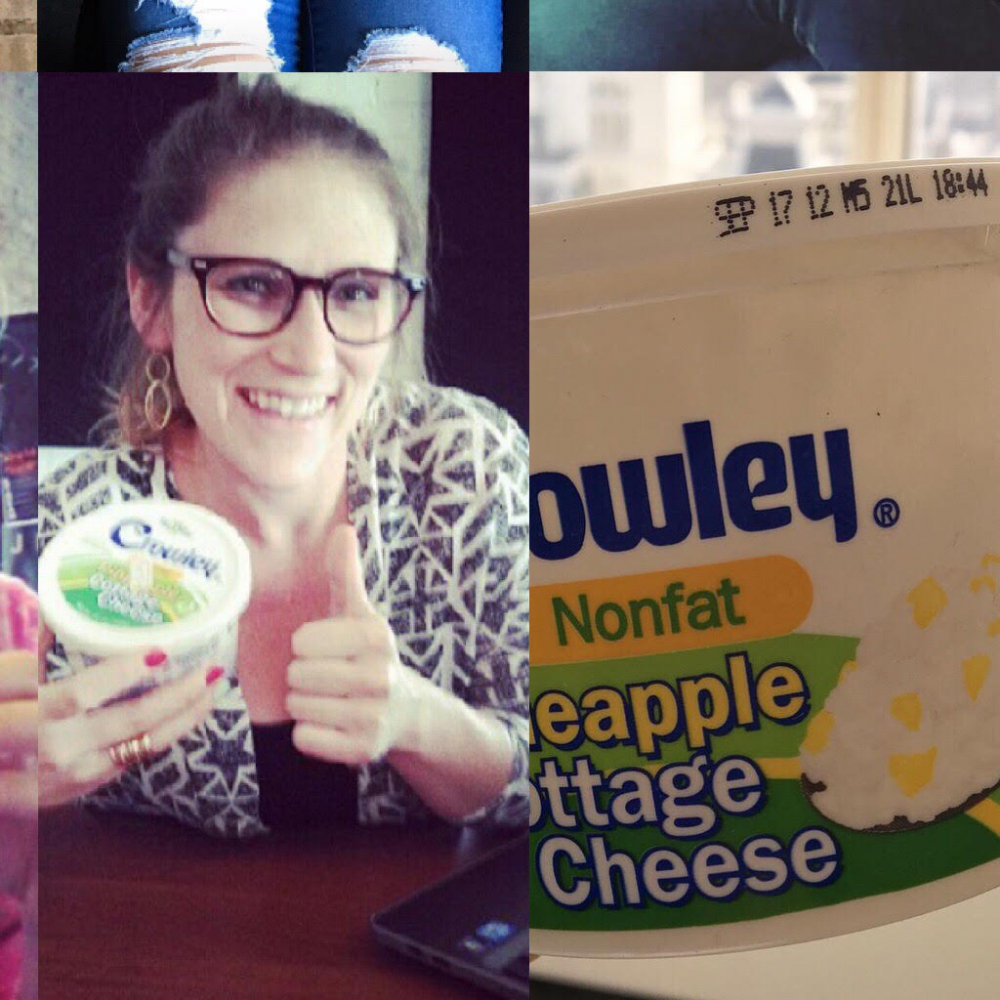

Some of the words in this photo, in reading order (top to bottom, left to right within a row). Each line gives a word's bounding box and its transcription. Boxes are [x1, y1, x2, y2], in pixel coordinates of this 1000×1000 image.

[769, 189, 793, 227] 17
[806, 184, 834, 220] 12
[552, 578, 746, 646] Nonfat
[537, 824, 843, 909] Cheese
